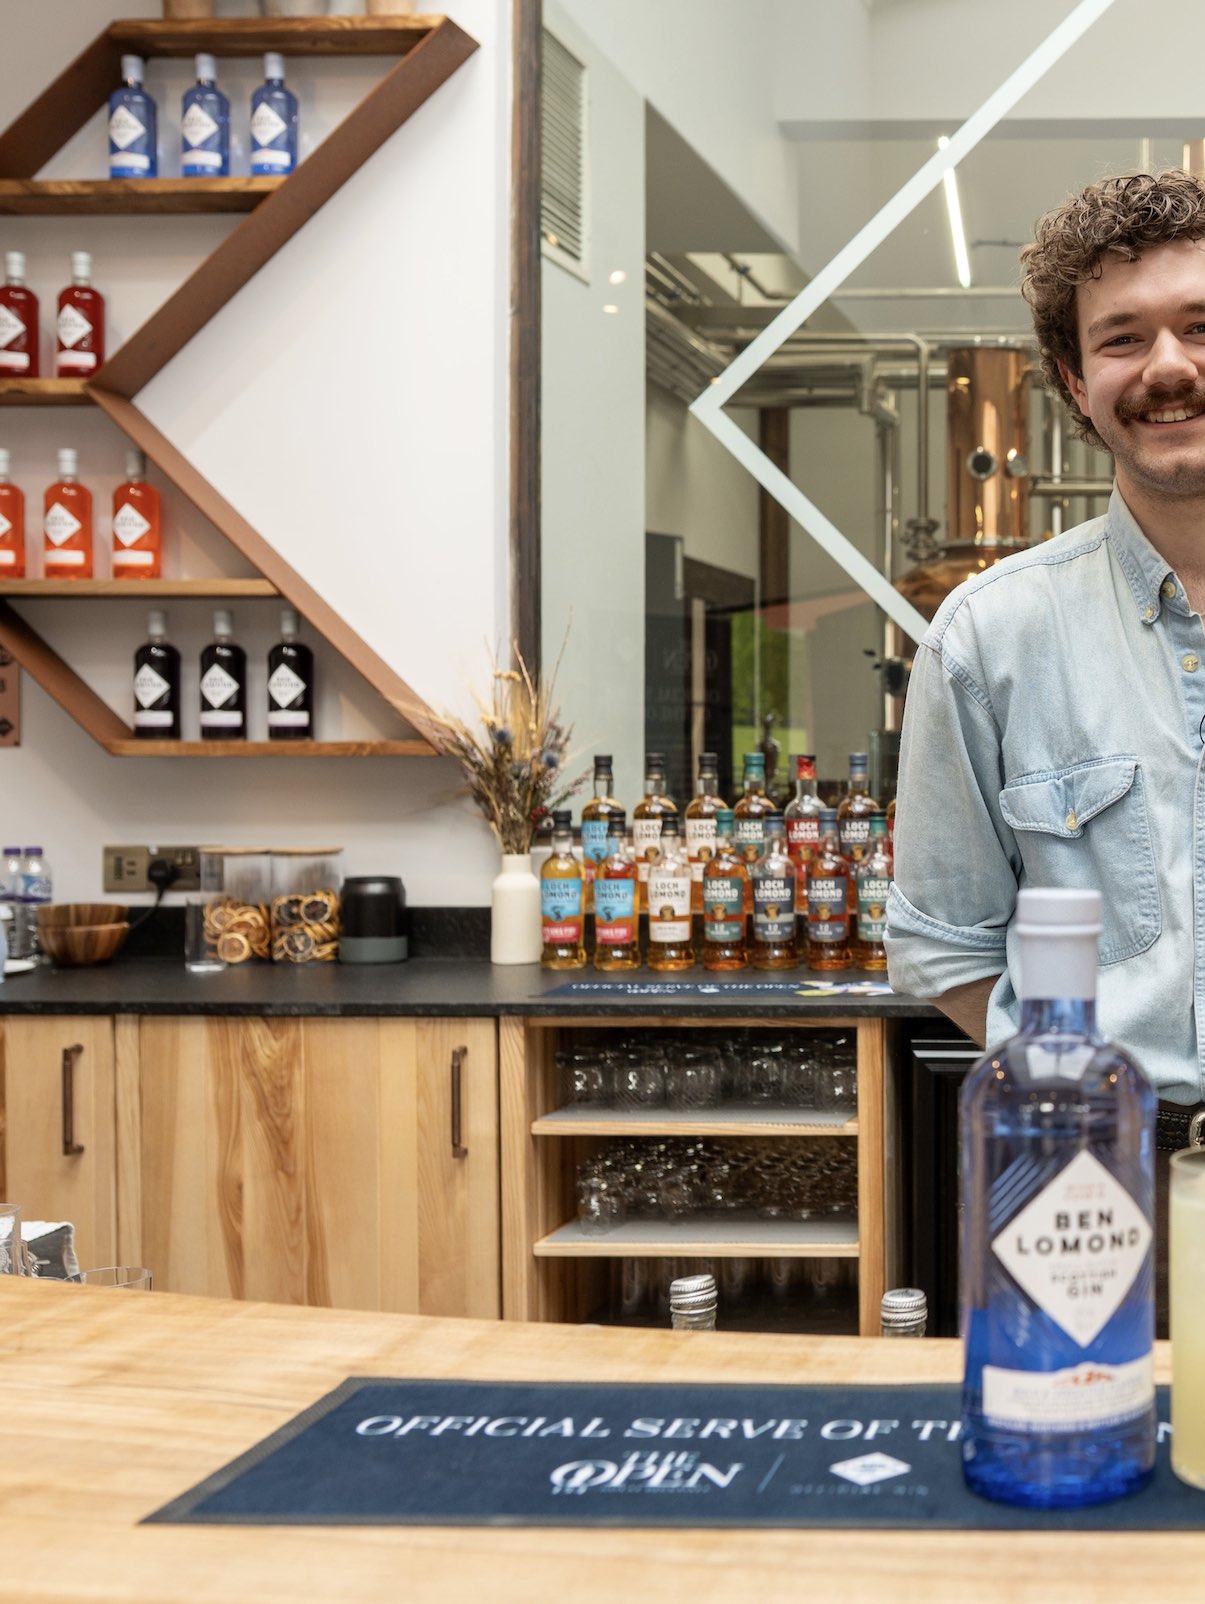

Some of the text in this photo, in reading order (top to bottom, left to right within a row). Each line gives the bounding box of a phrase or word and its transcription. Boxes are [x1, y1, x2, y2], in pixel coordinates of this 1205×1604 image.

[739, 821, 763, 831] LOCH
[794, 821, 818, 831] LOCH
[845, 821, 869, 831] LOCH
[736, 831, 764, 840] LOMON
[789, 831, 819, 840] LOMON
[655, 881, 679, 890] LOCH
[707, 879, 731, 889] LOCH
[759, 879, 784, 889] LOCH
[811, 879, 835, 889] LOCH
[754, 888, 791, 899] LOMOND
[1055, 1209, 1114, 1231] BEN
[1016, 1227, 1141, 1255] LOMOND
[1066, 1284, 1104, 1298] GIN
[355, 1415, 611, 1438] OFFICIAL
[623, 1416, 808, 1440] SERVE
[820, 1418, 900, 1441] OF
[550, 1458, 746, 1489] OPEN
